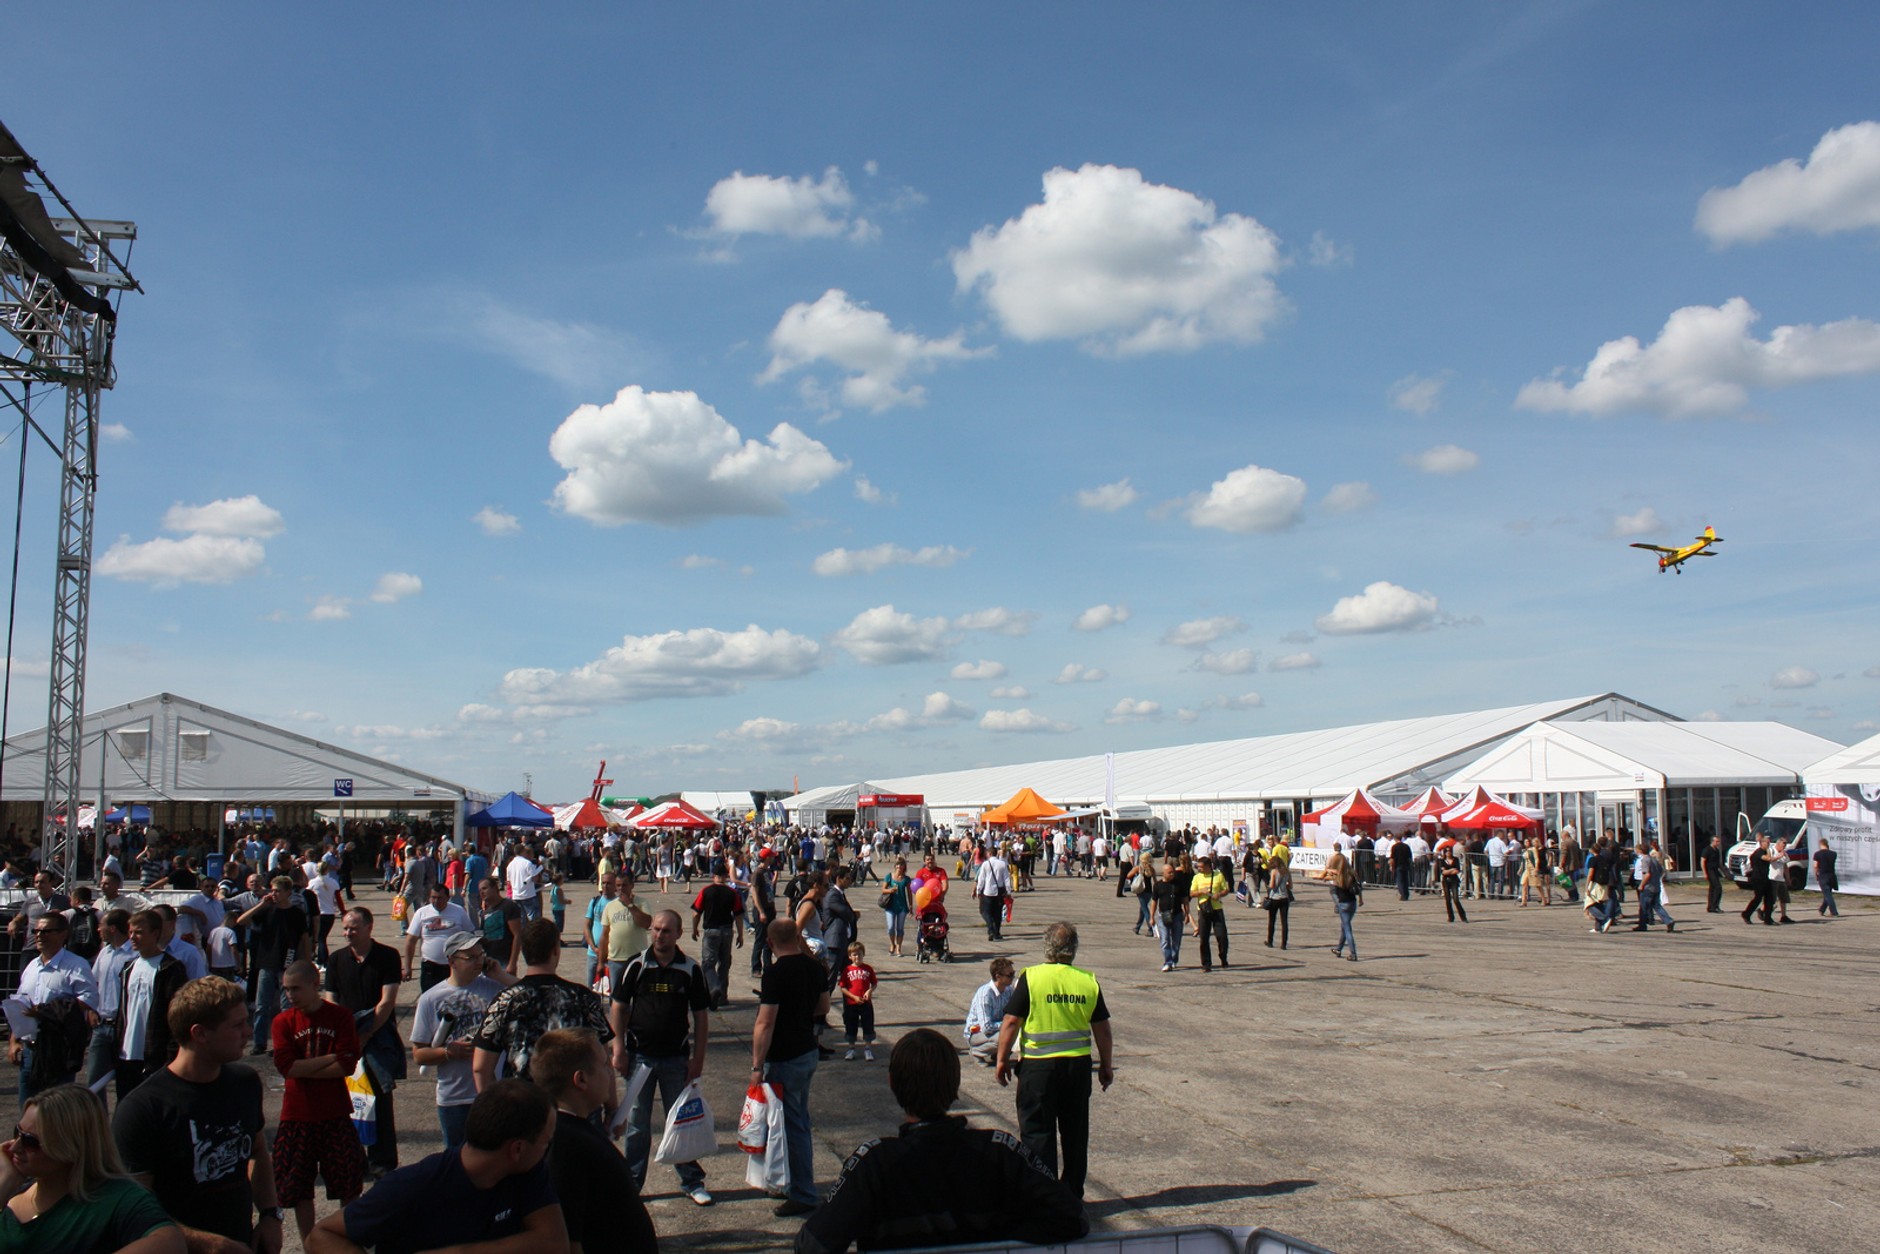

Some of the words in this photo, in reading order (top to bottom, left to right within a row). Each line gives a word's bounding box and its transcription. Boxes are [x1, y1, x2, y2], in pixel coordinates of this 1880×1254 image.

[336, 780, 352, 788] WC
[1295, 852, 1328, 865] CATERIN
[1046, 994, 1087, 1004] OCHRONA
